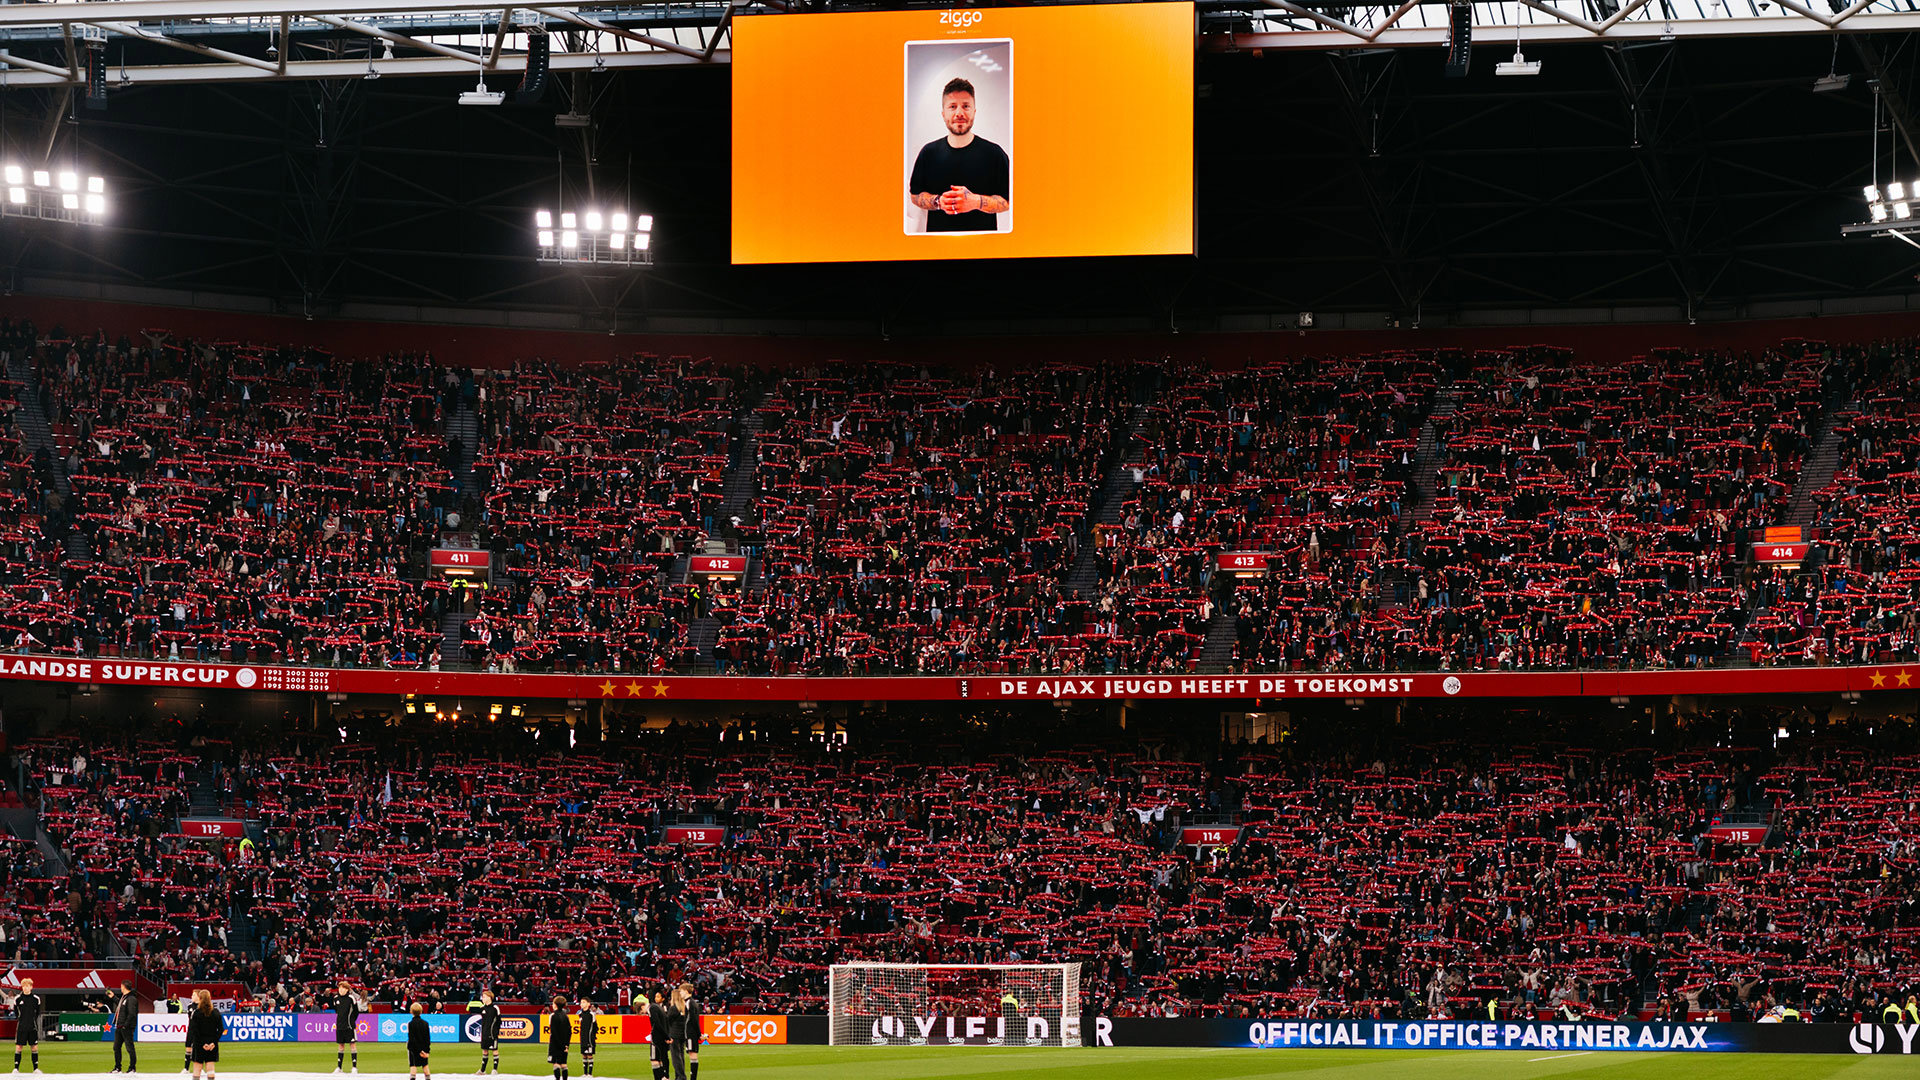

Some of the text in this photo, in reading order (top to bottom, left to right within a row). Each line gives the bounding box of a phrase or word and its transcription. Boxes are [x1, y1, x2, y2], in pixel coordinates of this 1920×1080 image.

[940, 9, 982, 27] ziggo
[1772, 547, 1793, 557] 414
[451, 553, 469, 563] 411
[1234, 556, 1255, 566] 413
[709, 559, 729, 569] 412
[0, 659, 230, 683] LANDSE SUPERCUP
[1001, 678, 1414, 698] DE AJAX JEUGD HEEFT DE TOEKOMST
[202, 824, 221, 834] 112
[687, 831, 705, 840] 113
[1203, 832, 1221, 841] 114
[1731, 831, 1749, 840] 115
[223, 1015, 293, 1027] VRIENDEN
[500, 1020, 524, 1029] LLSAFE
[61, 1023, 101, 1032] Heineken
[609, 1026, 618, 1034] IT
[713, 1016, 777, 1043] ziggo
[232, 1028, 284, 1040] LOTERIJ
[1249, 1022, 1708, 1048] OFFICIAL IT OFFICE PARTNER AJAX
